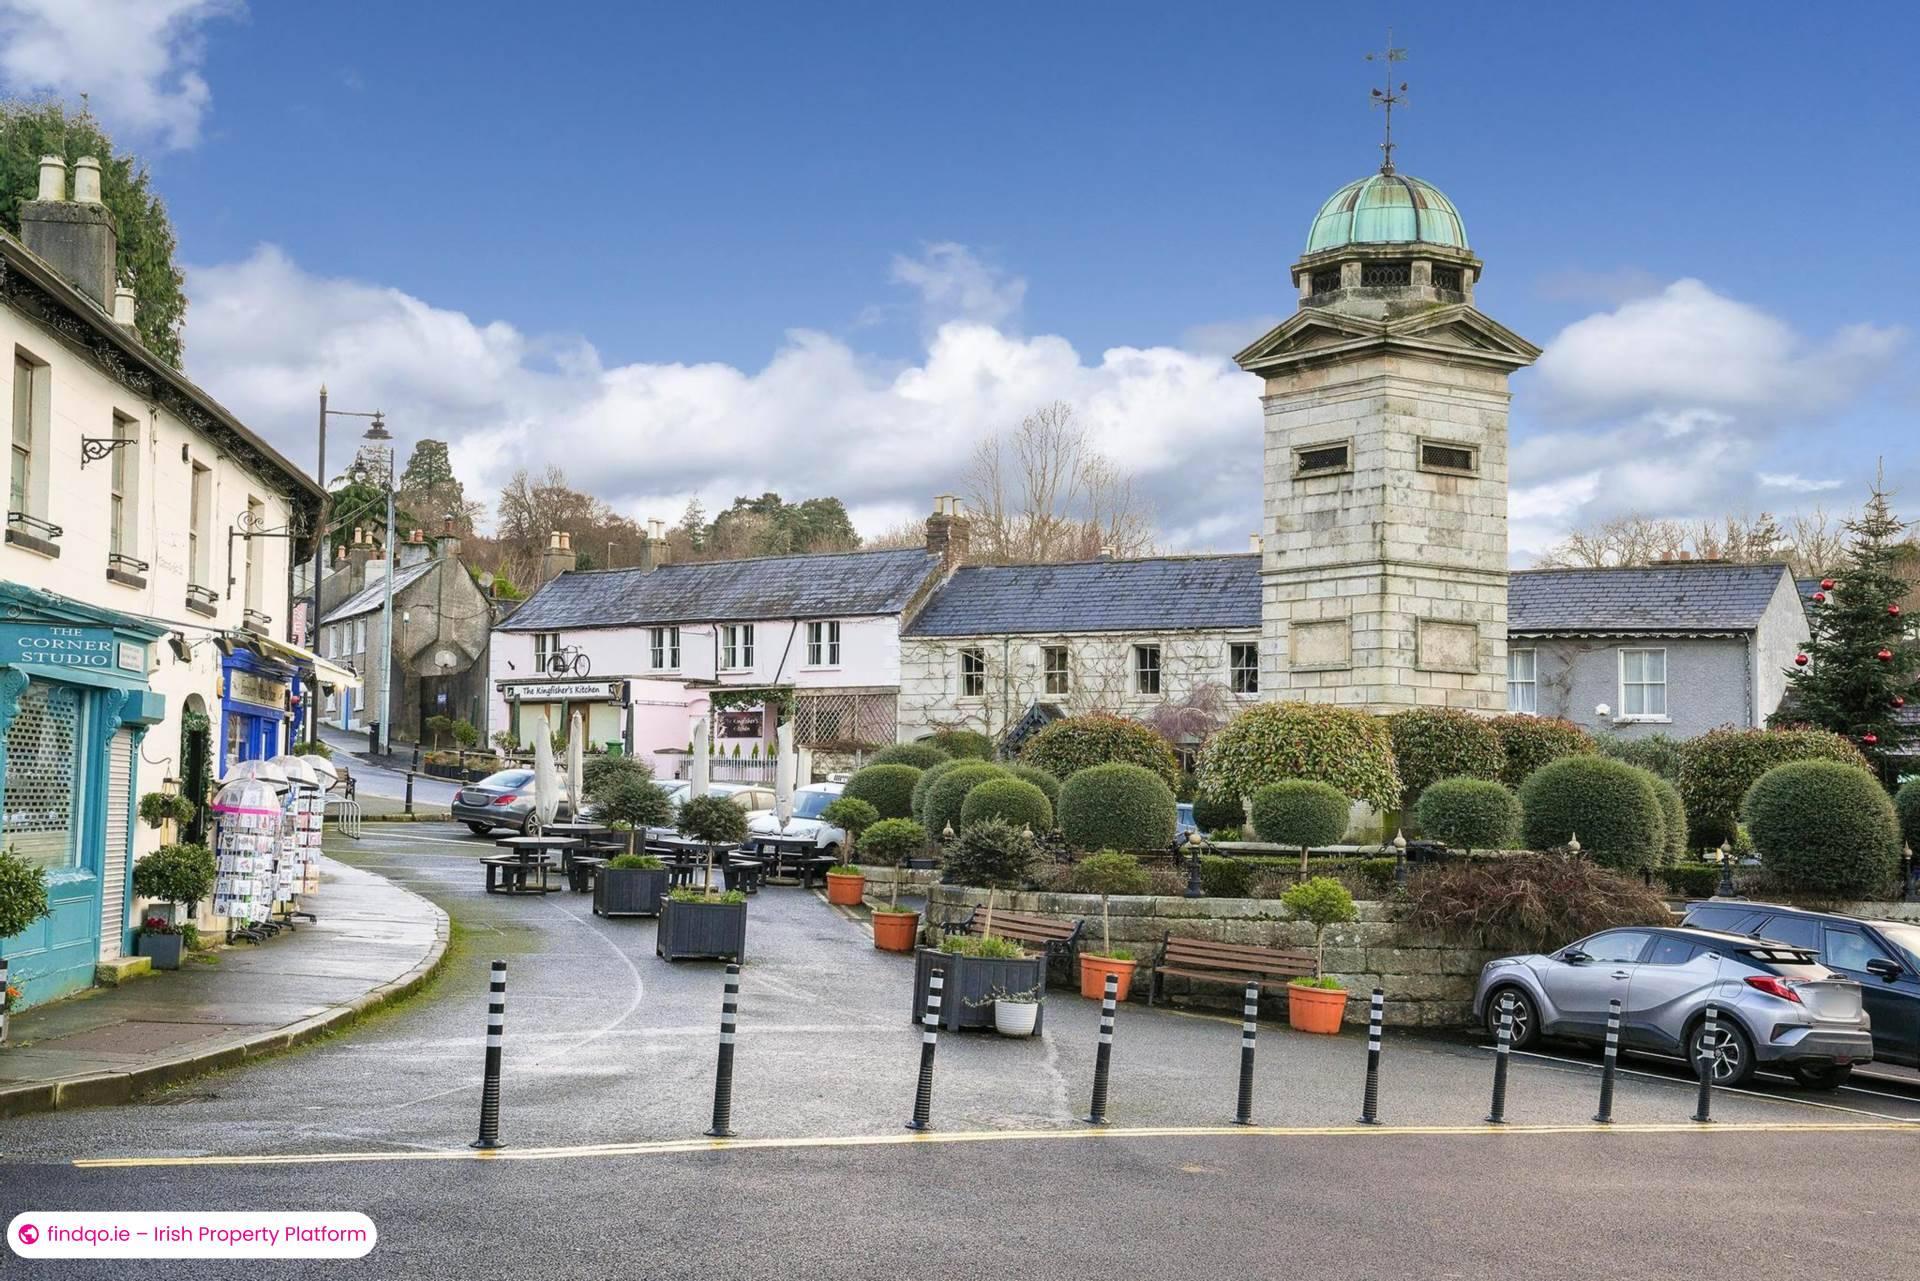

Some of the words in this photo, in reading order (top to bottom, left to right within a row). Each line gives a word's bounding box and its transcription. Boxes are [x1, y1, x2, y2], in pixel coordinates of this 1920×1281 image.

[51, 628, 82, 636] THE
[18, 637, 112, 651] CORNER
[21, 651, 108, 666] STUDIO
[536, 685, 573, 697] Kingfisher's
[575, 685, 600, 694] Kitchen
